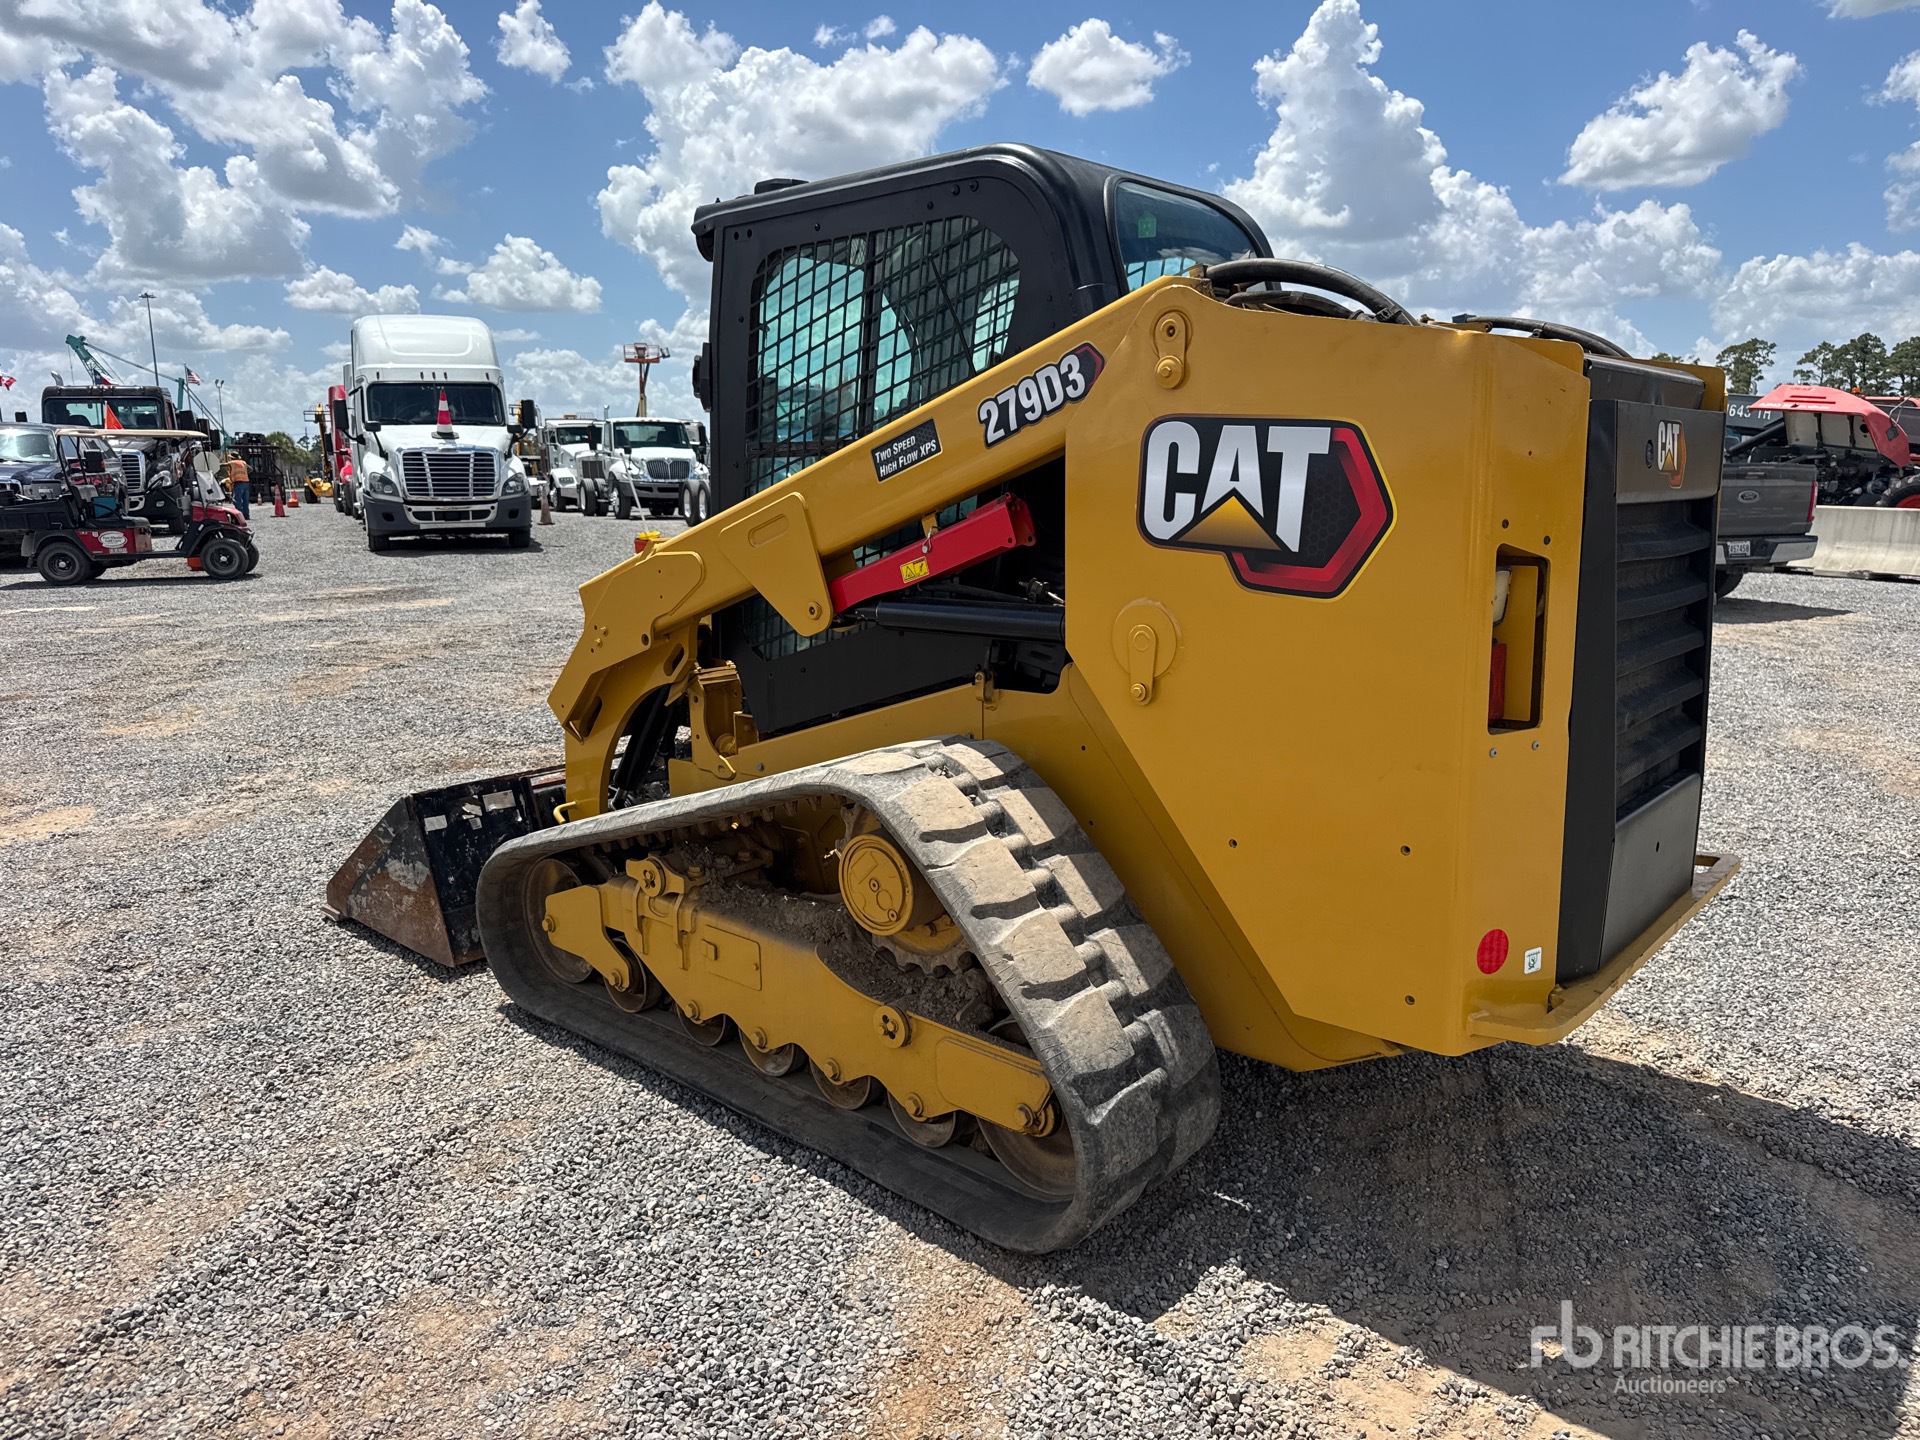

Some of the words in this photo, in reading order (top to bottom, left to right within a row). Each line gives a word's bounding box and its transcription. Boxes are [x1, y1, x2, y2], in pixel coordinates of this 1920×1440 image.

[979, 353, 1087, 445] 279D3
[920, 439, 937, 459] XPS
[1657, 421, 1680, 471] CAT
[1144, 421, 1331, 553] CAT
